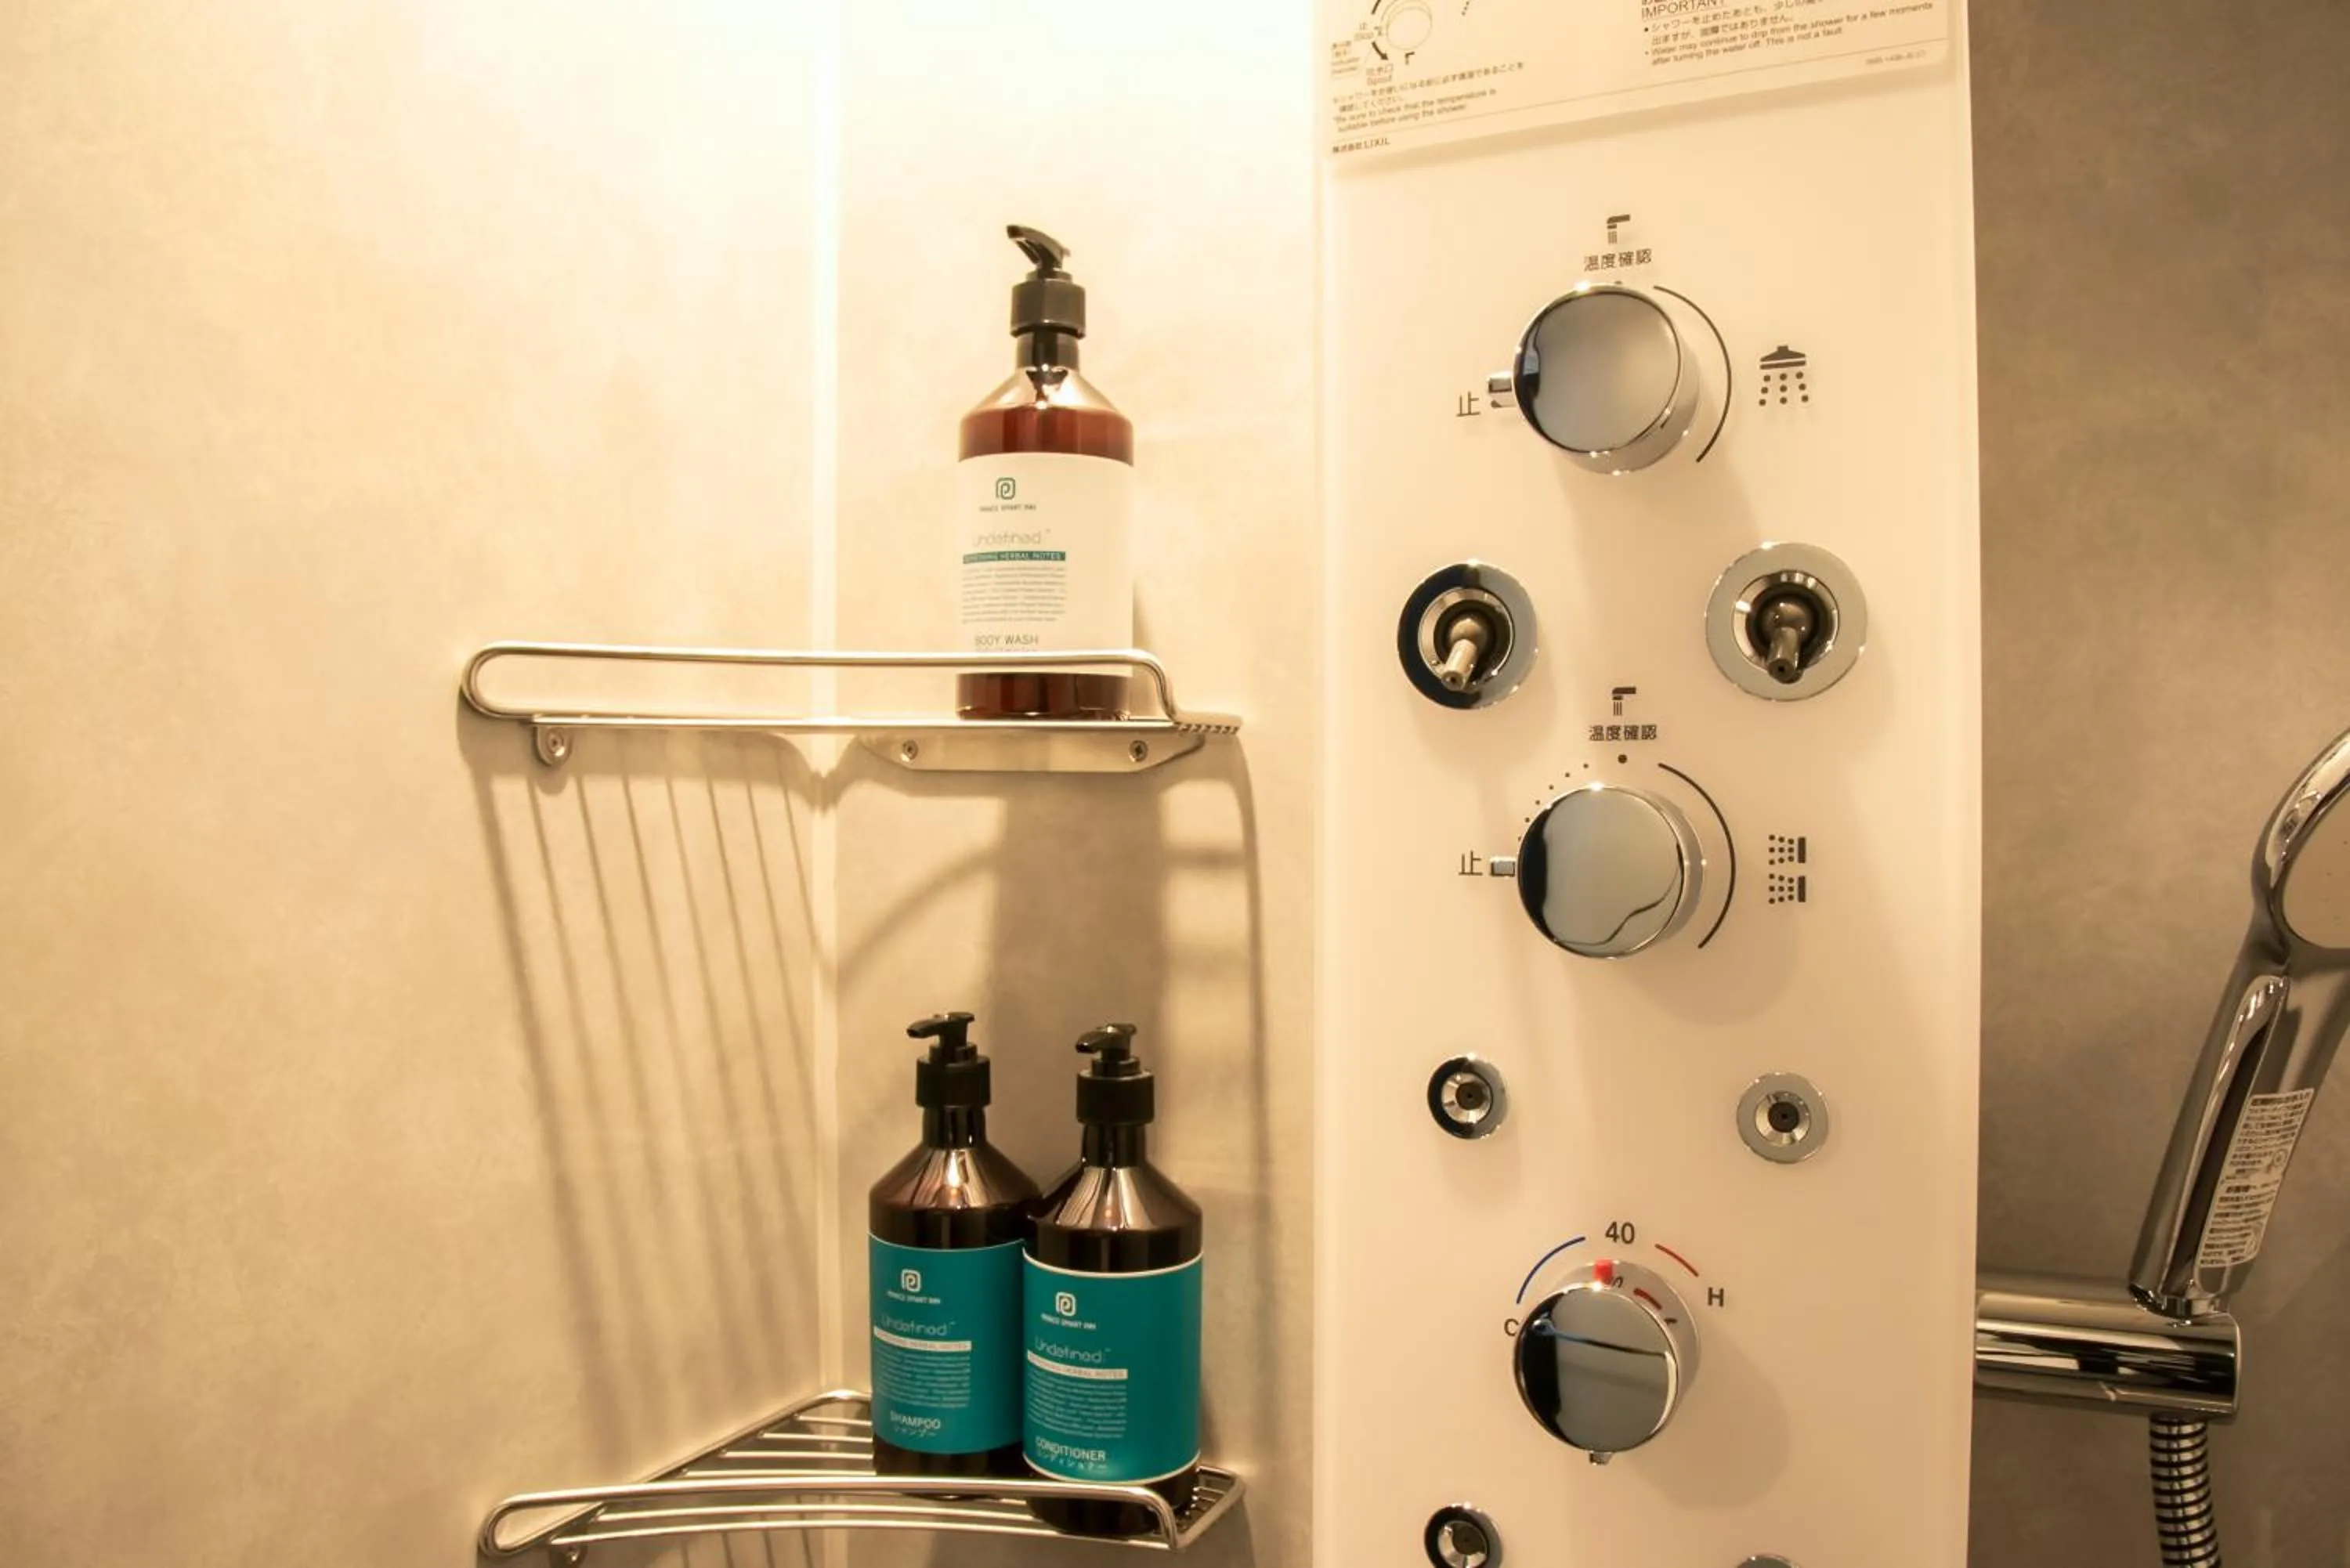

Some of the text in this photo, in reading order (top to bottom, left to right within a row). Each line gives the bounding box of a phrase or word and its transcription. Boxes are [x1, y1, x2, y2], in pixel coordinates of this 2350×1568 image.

[1652, 45, 1677, 56] Water
[1700, 36, 1737, 47] continue
[1751, 31, 1768, 40] drip
[1770, 26, 1791, 34] from
[1793, 23, 1807, 31] the
[1810, 18, 1843, 28] shower
[1888, 2, 1932, 15] moments
[1652, 56, 1671, 66] after
[1673, 51, 1704, 62] turning
[1706, 48, 1719, 56] the
[1723, 43, 1746, 53] water
[1766, 37, 1784, 46] This
[1797, 31, 1811, 41] not
[1584, 248, 1652, 272] 温度確認
[1456, 392, 1480, 417] 止
[975, 634, 1038, 647] BODY WASH
[1589, 724, 1658, 742] 温度確認
[1458, 851, 1483, 876] 止
[1605, 1222, 1636, 1245] 40
[1708, 1288, 1724, 1307] H
[1504, 1318, 1519, 1337] C
[890, 1410, 941, 1429] SHAMPOO
[1035, 1436, 1105, 1462] CONDITIONER
